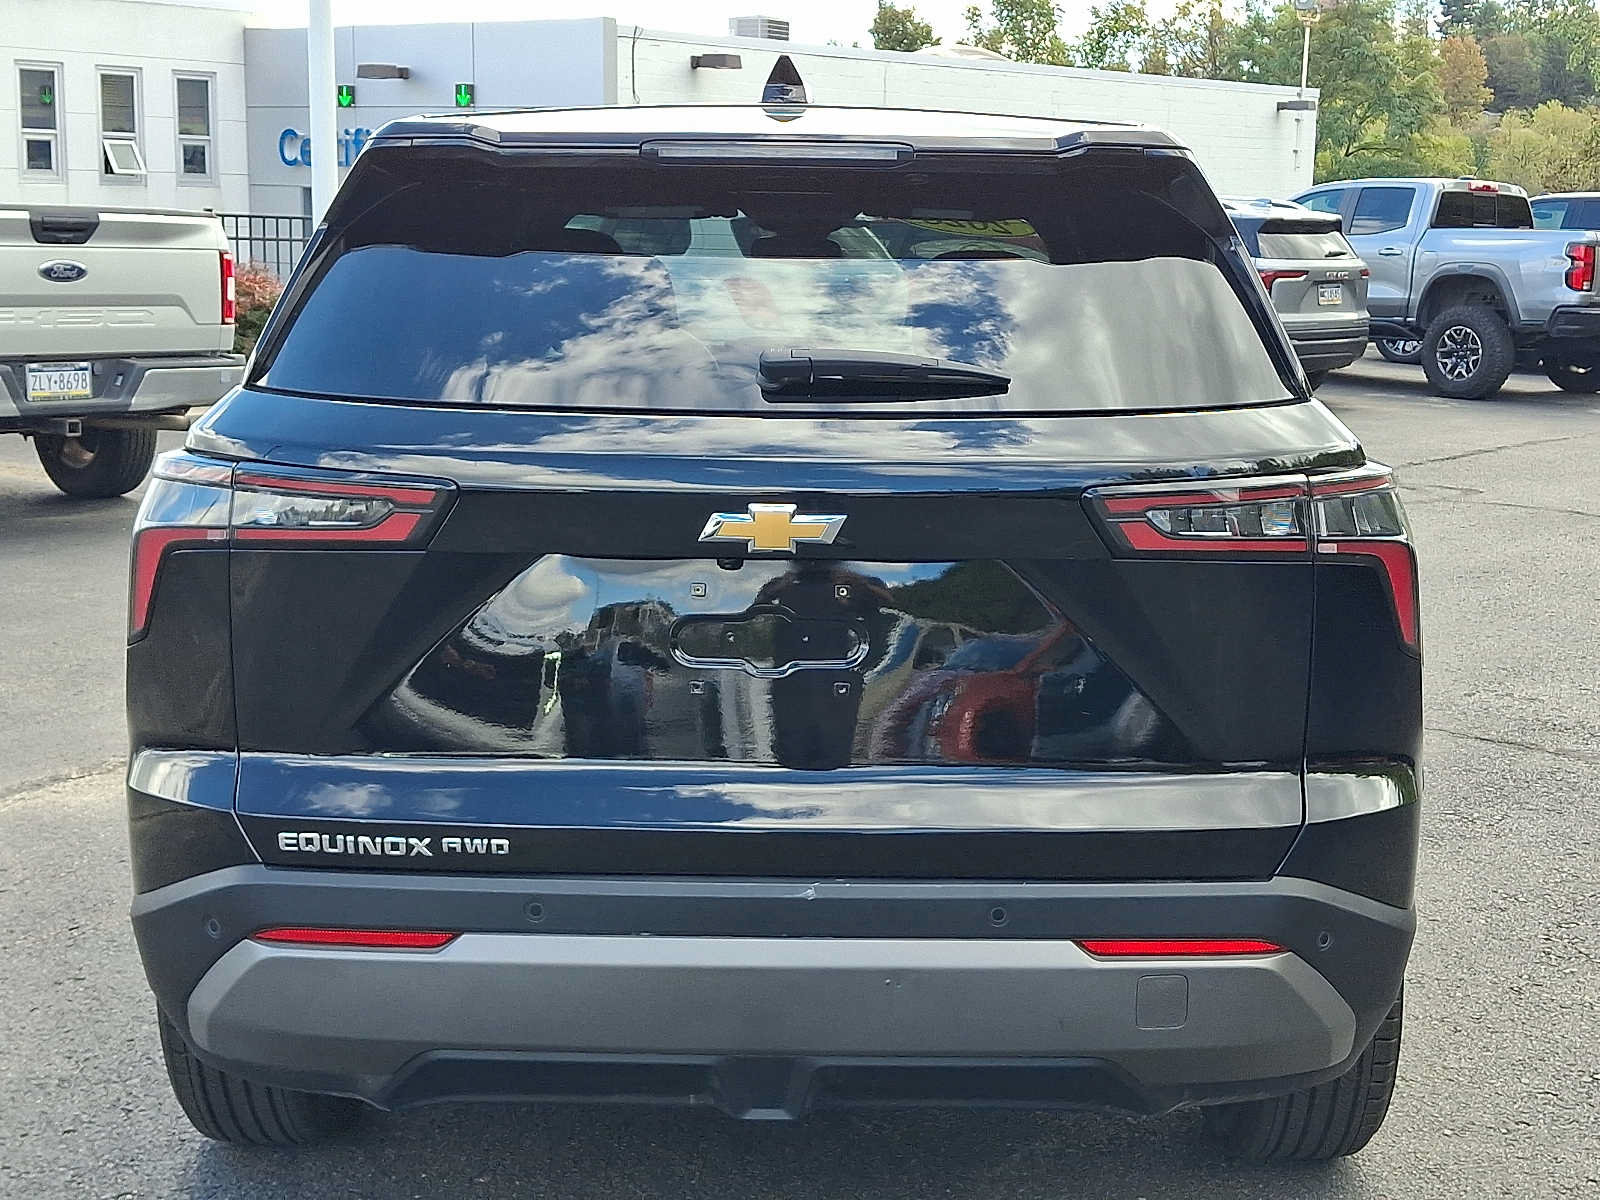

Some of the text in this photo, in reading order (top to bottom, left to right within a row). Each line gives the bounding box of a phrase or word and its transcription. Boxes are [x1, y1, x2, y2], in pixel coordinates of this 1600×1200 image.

[50, 263, 79, 278] Ford
[278, 832, 510, 857] EQUINOX AWD
